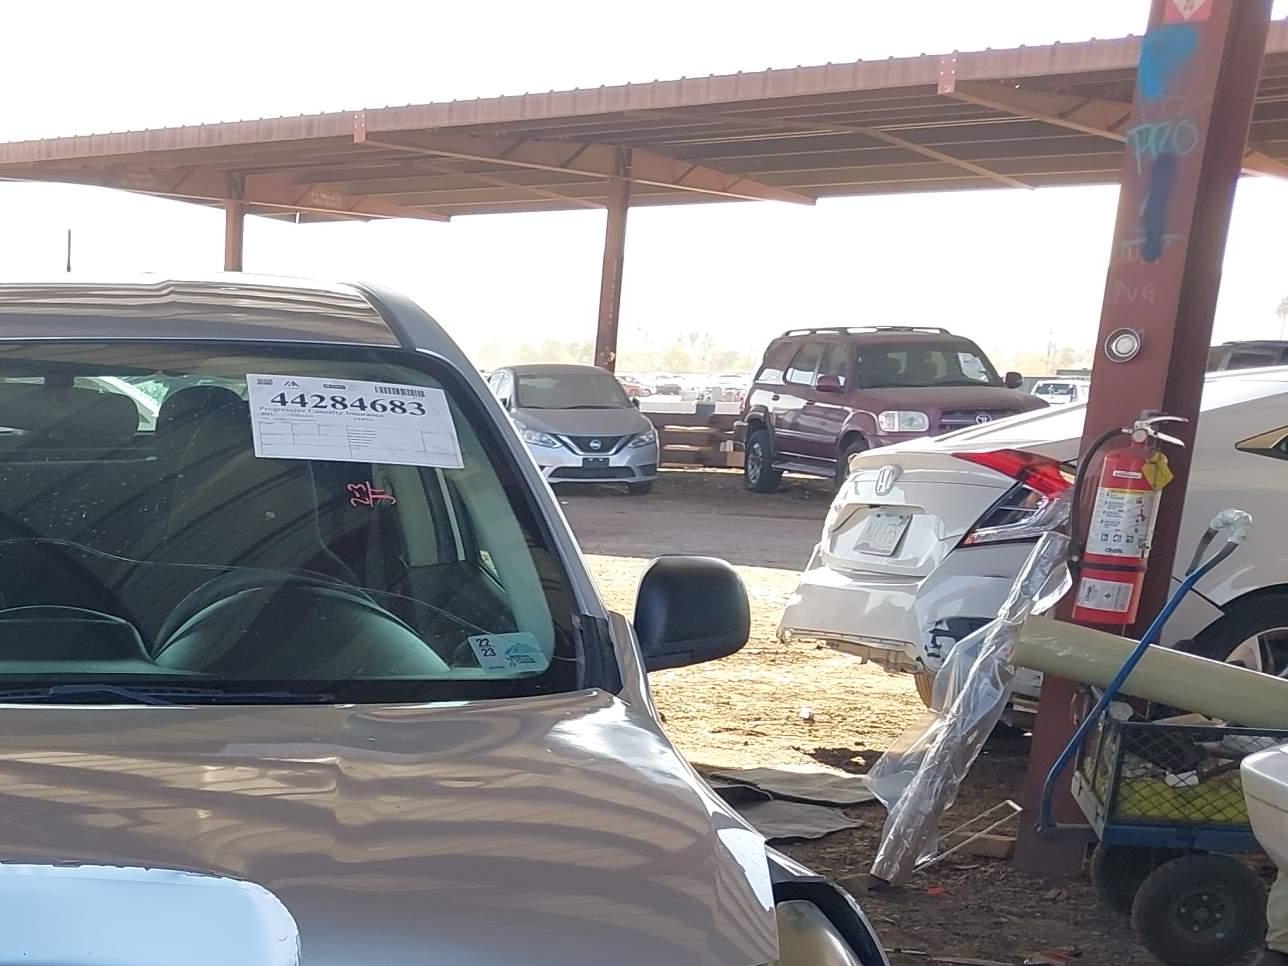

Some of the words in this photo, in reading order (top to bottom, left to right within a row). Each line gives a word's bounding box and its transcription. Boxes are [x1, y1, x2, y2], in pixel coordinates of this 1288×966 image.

[270, 392, 427, 416] 44284683
[259, 405, 306, 414] Progressive
[475, 637, 492, 647] 22
[480, 648, 497, 657] 23
